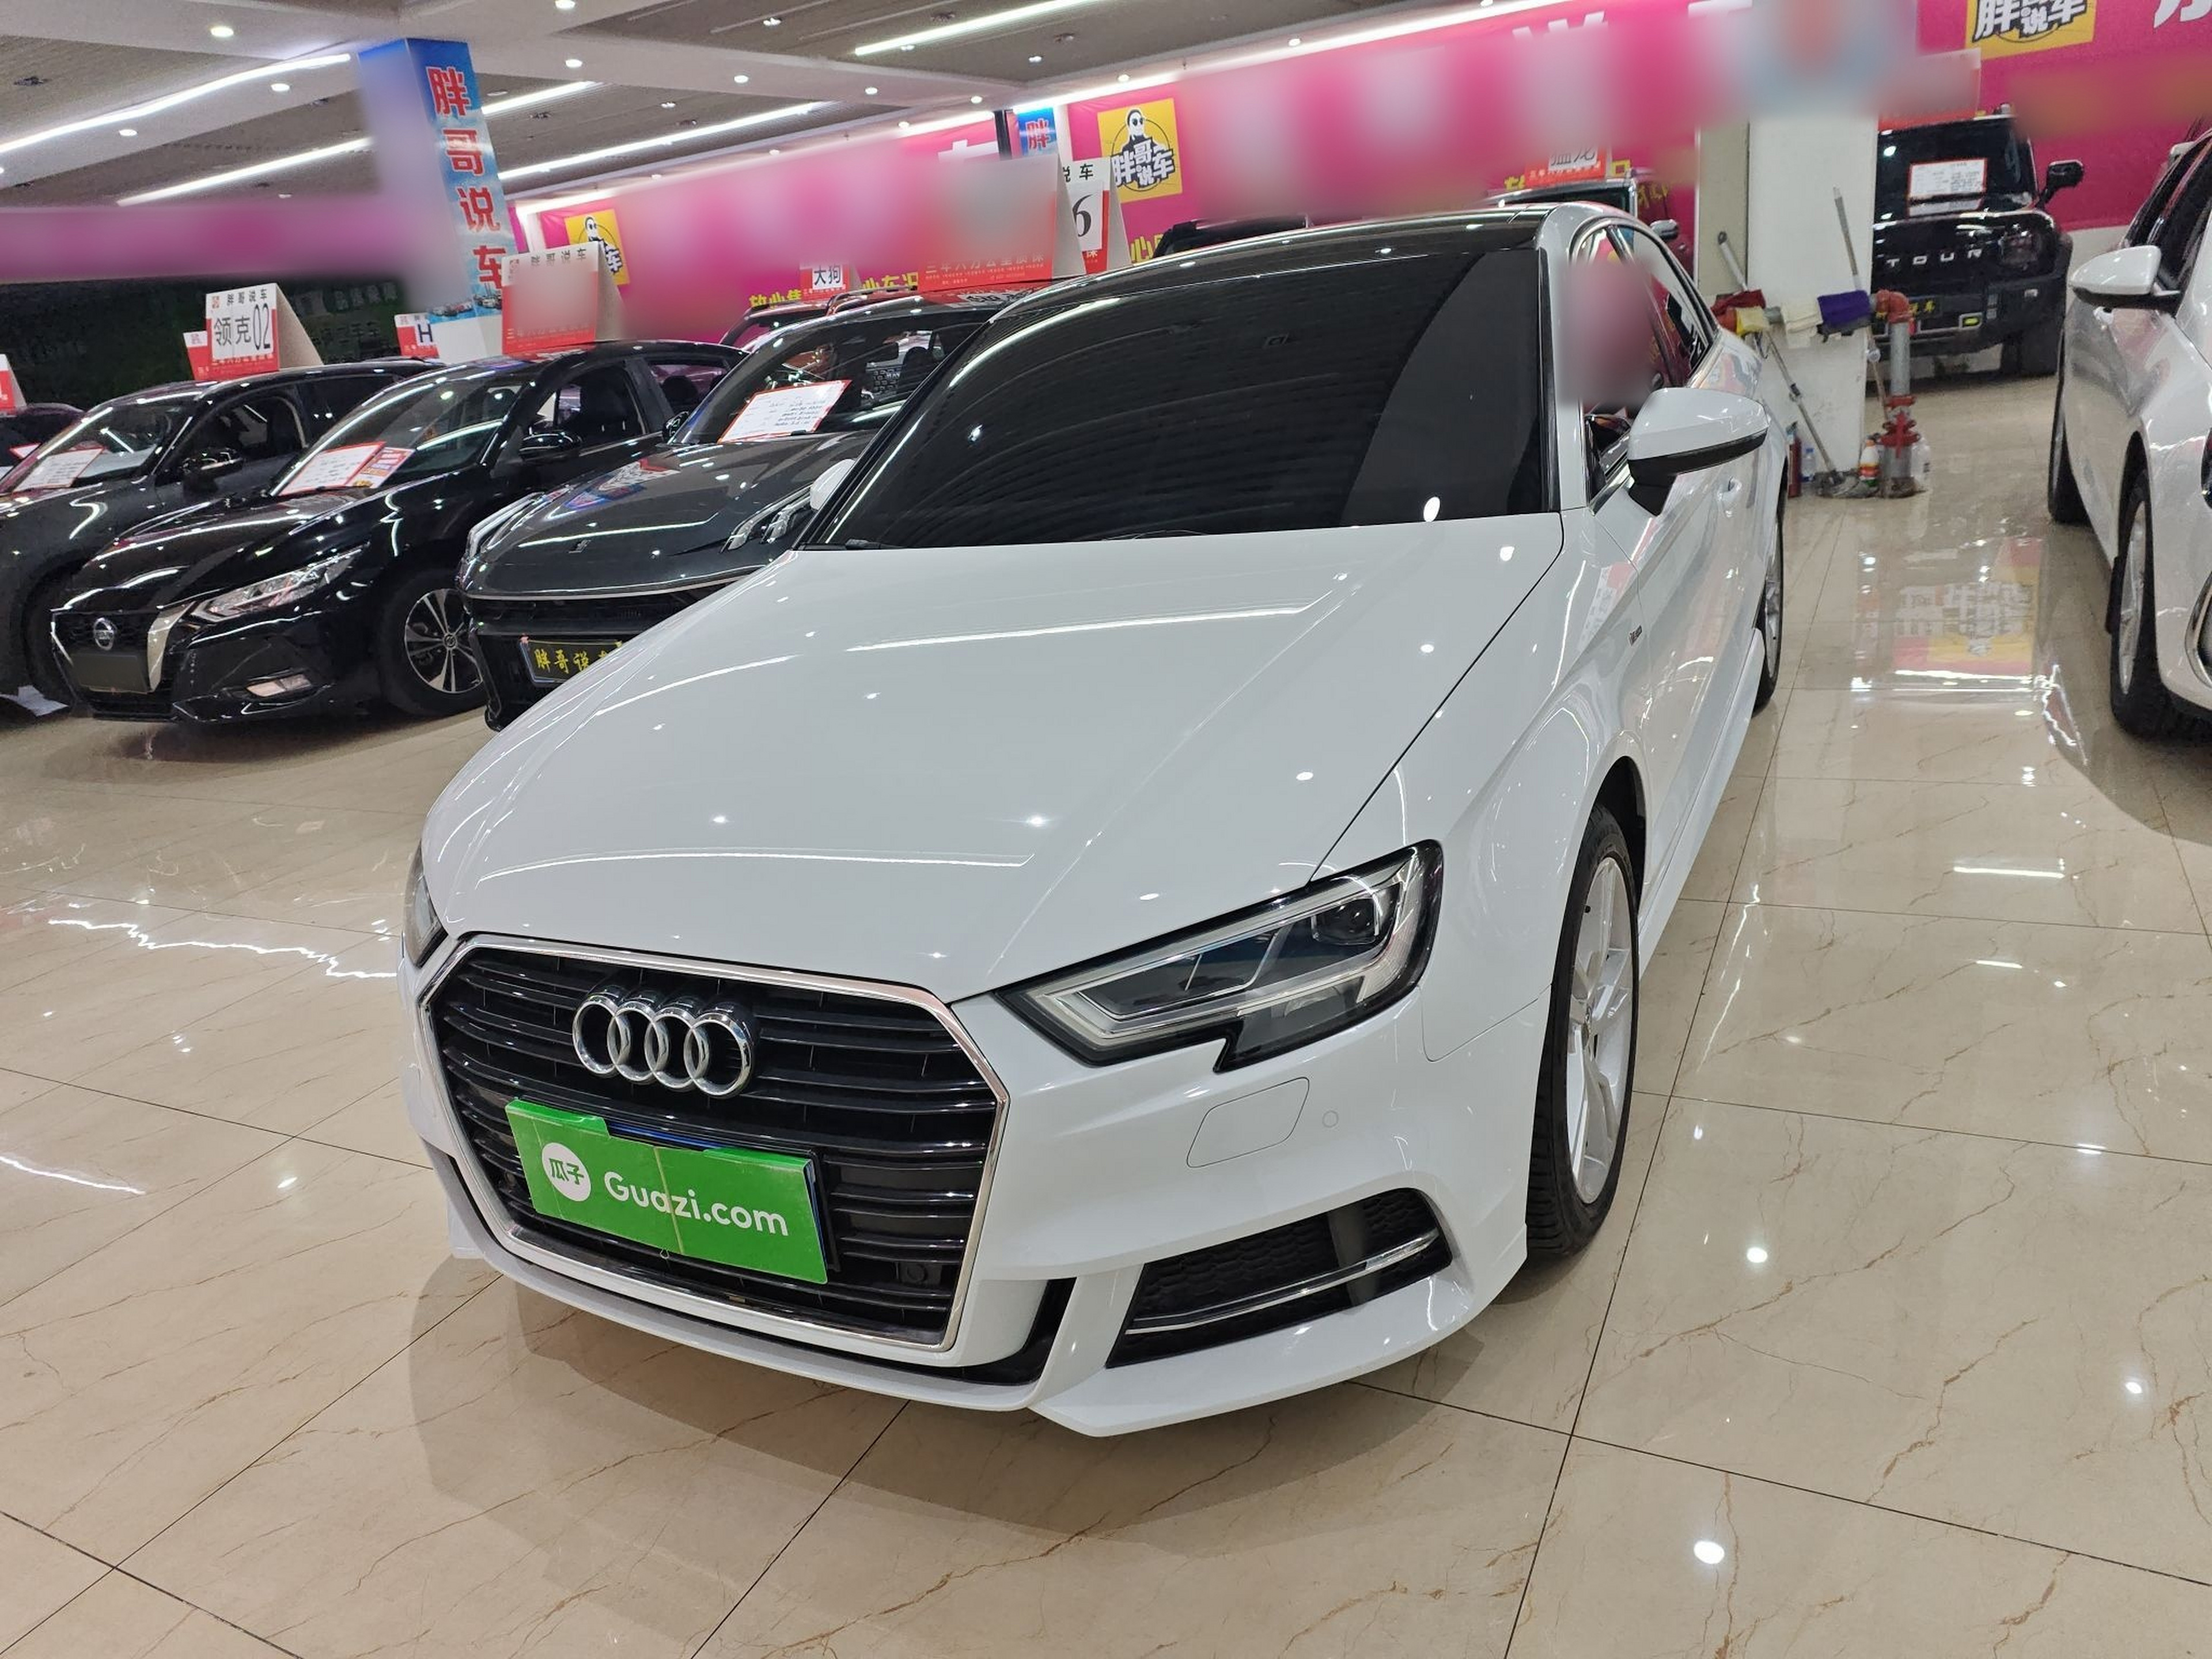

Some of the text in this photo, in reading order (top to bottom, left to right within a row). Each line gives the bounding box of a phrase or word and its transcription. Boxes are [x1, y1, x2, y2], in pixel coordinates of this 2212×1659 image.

[1974, 0, 2086, 41] 胖说车
[427, 66, 505, 290] 胖哥说车
[1111, 137, 1176, 187] 胖哥说车
[550, 1157, 585, 1187] 瓜子
[604, 1171, 789, 1237] Guazi.com
